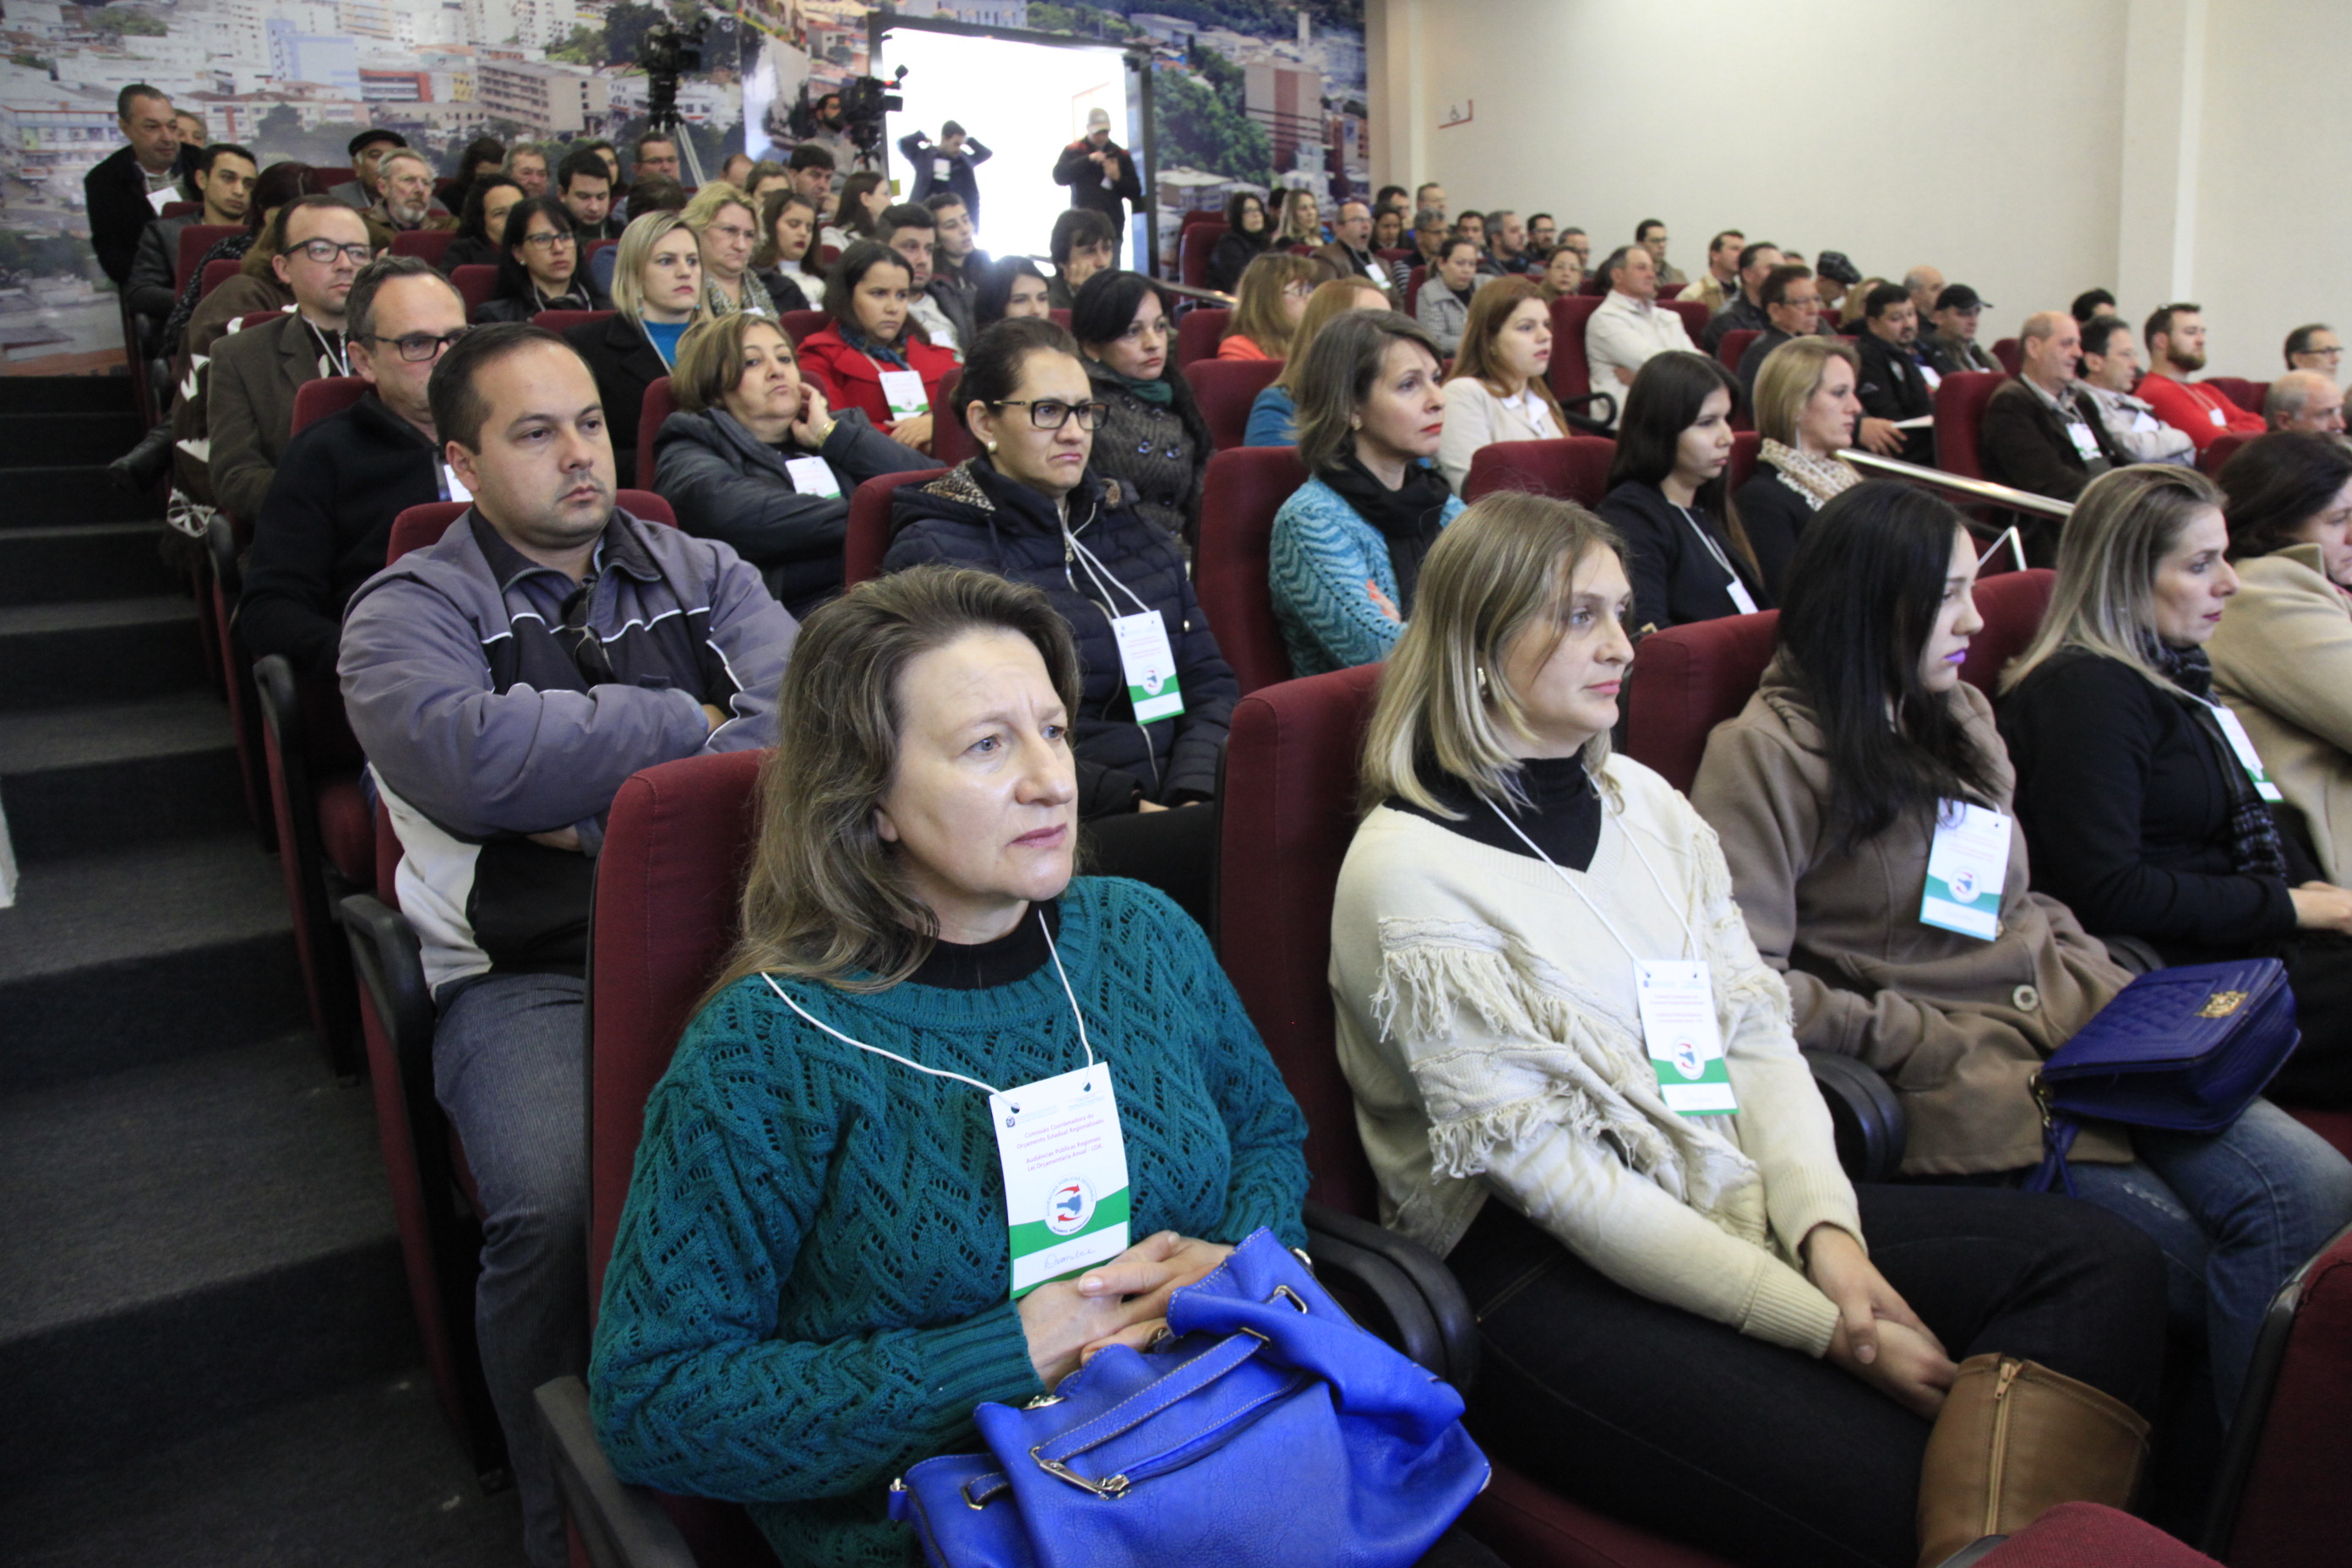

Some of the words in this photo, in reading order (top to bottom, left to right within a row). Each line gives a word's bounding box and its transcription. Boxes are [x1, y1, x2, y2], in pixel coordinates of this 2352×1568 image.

[1016, 1136, 1046, 1149] Orçamento
[1047, 1129, 1069, 1140] Estadual
[1069, 1119, 1104, 1133] Regionalizado
[1025, 1127, 1049, 1138] Comissão
[1076, 1136, 1101, 1147] Regionais
[1091, 1143, 1102, 1152] LOA
